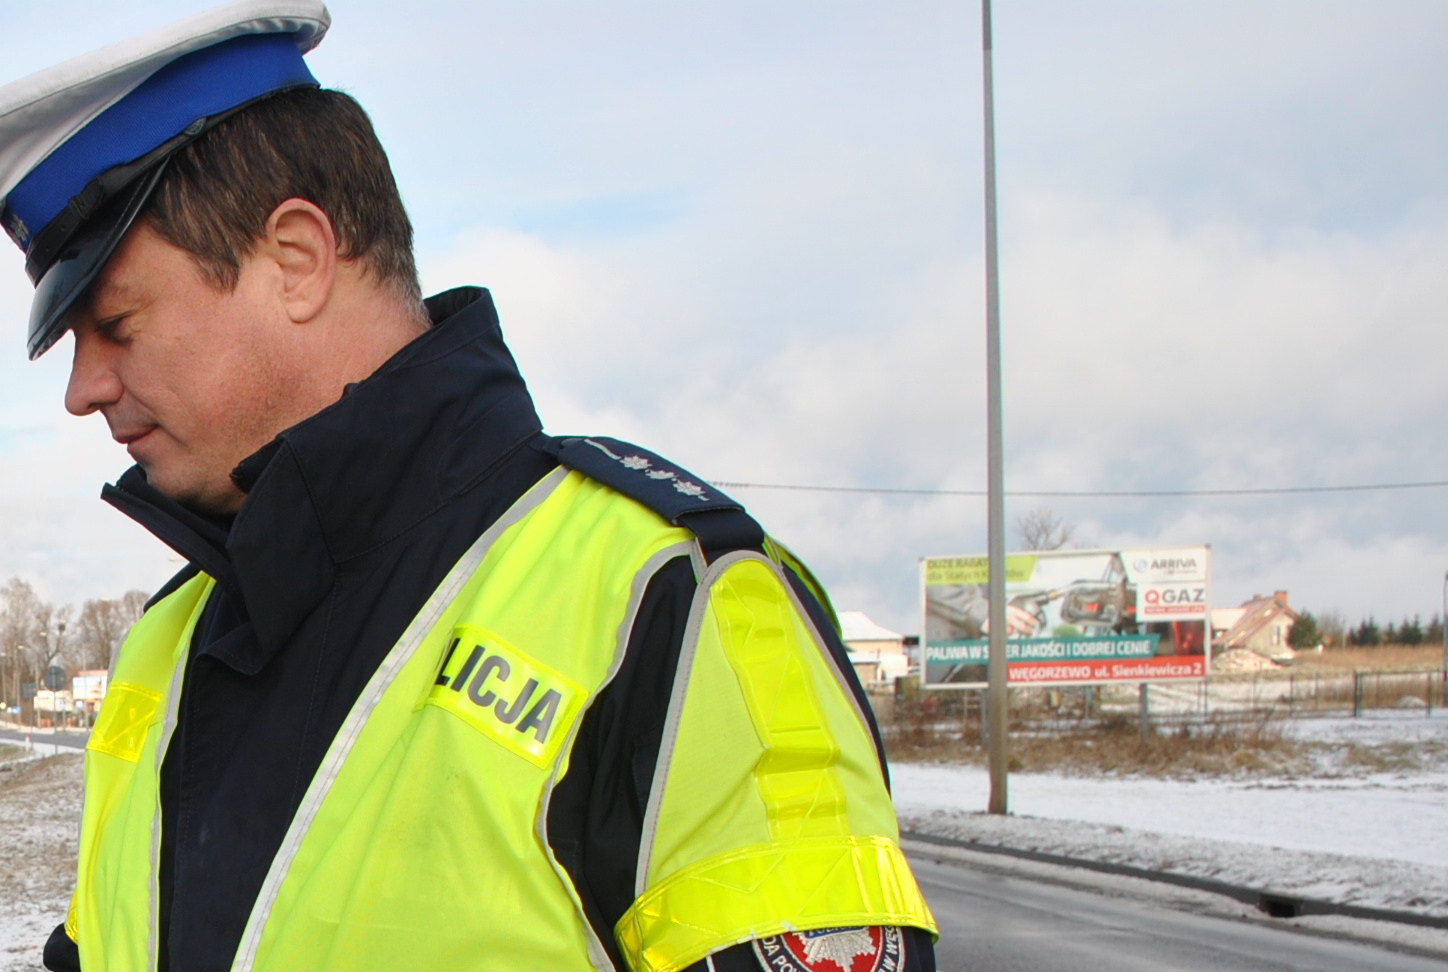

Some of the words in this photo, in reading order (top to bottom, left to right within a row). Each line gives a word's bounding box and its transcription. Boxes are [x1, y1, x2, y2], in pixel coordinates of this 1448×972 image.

[1150, 558, 1197, 569] ARRIVA
[926, 645, 967, 660] PALIWA
[968, 645, 981, 658] W
[1021, 640, 1065, 658] JAKOŚCI
[1074, 642, 1115, 657] DOBREJ
[1117, 640, 1151, 656] CENIE
[1009, 665, 1091, 682] WĘGORZEWO
[1095, 666, 1109, 677] ul.
[1111, 663, 1191, 678] Sienkiewicza
[1193, 662, 1202, 676] 2
[434, 636, 562, 744] LICJA
